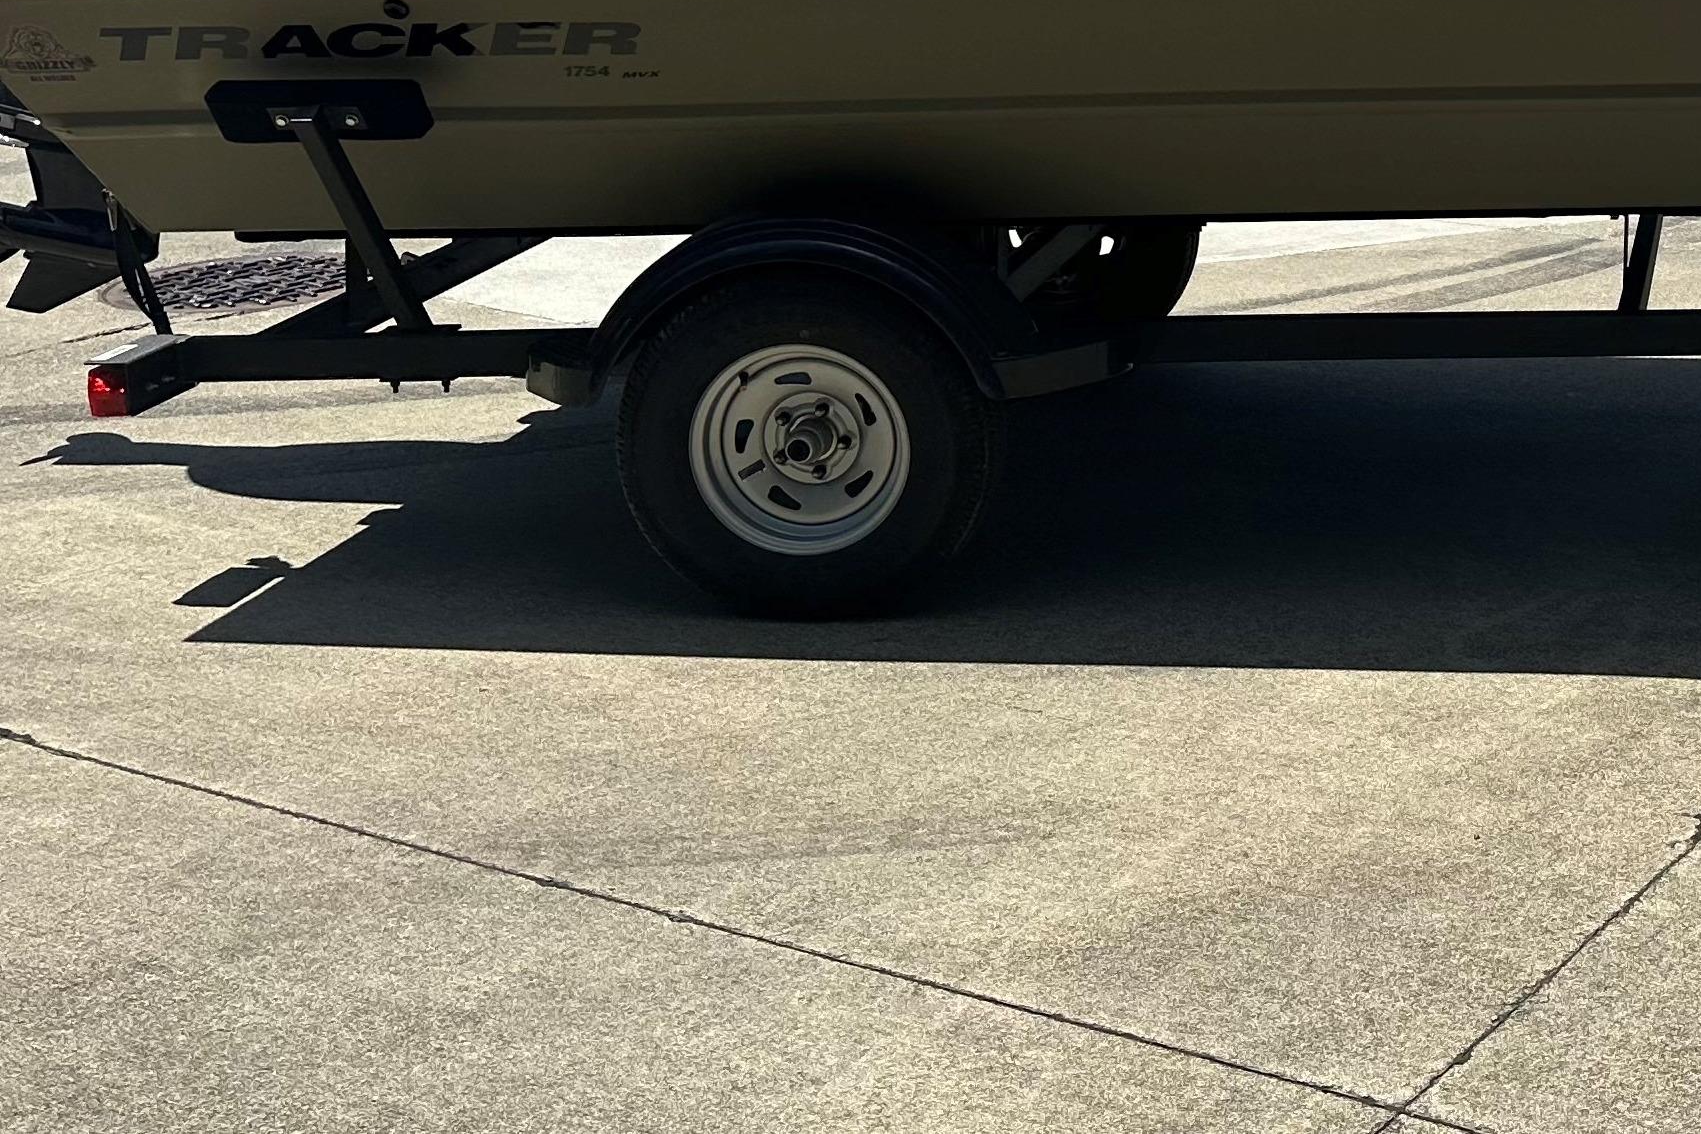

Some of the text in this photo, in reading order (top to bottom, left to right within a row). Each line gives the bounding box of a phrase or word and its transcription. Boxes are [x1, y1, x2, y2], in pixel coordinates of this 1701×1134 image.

[99, 22, 639, 61] TRACKER
[16, 58, 75, 70] GRIZZLY
[563, 66, 610, 77] 1754
